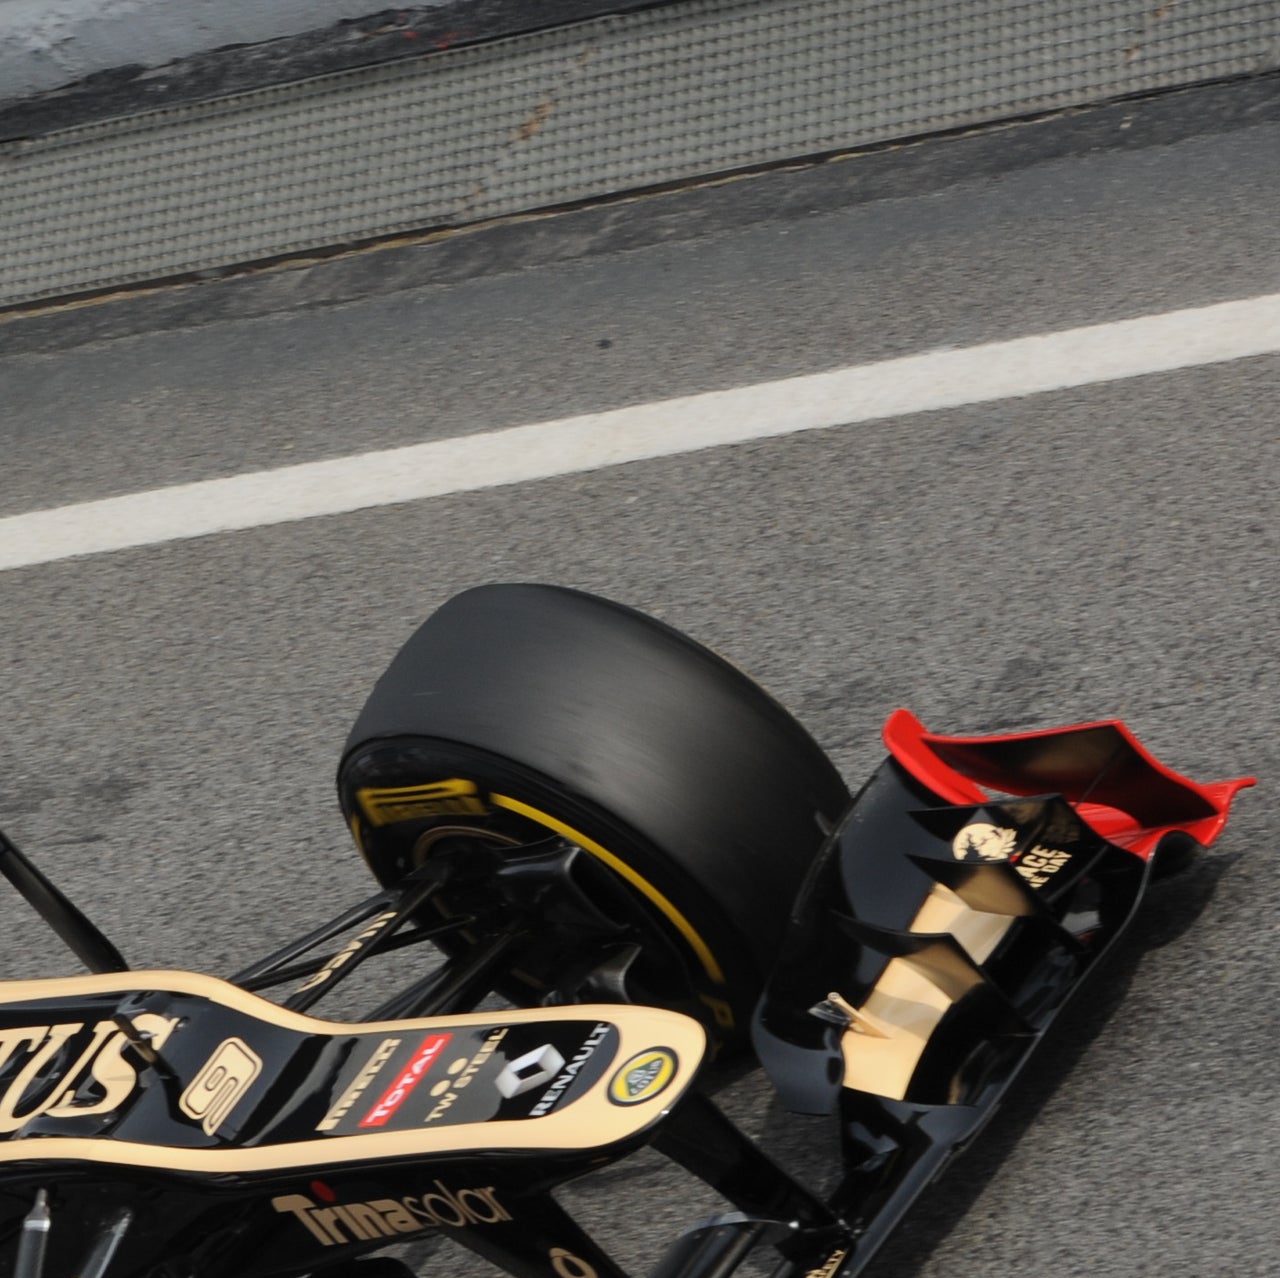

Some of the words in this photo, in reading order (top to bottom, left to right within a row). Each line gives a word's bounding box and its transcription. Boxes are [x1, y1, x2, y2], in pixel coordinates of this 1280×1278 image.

[179, 1037, 263, 1136] 9
[366, 1038, 444, 1123] TOTAL
[424, 1092, 458, 1122] TW
[529, 1022, 611, 1117] RENAULT
